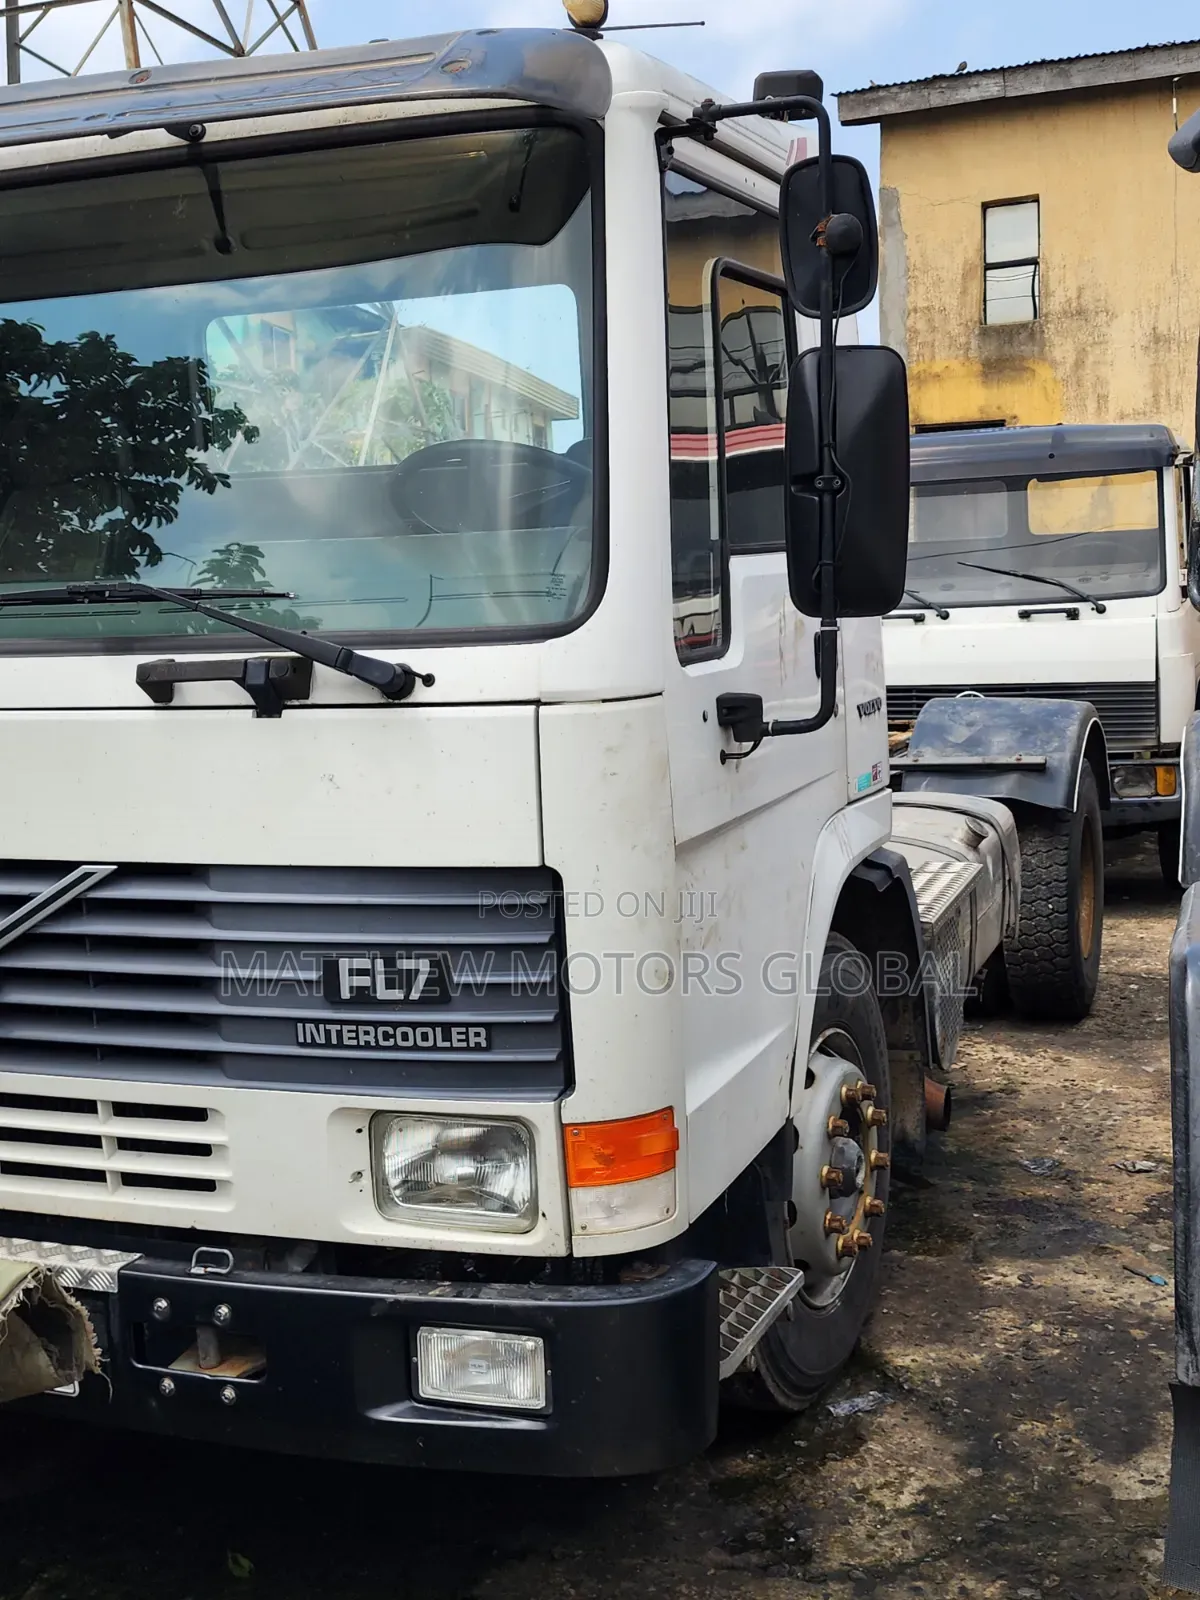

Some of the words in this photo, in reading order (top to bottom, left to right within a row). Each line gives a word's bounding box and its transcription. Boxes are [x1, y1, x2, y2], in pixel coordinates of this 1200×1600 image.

[857, 697, 882, 719] VOLVO
[338, 958, 430, 1001] FL7
[296, 1022, 487, 1048] INTERCOOLER
